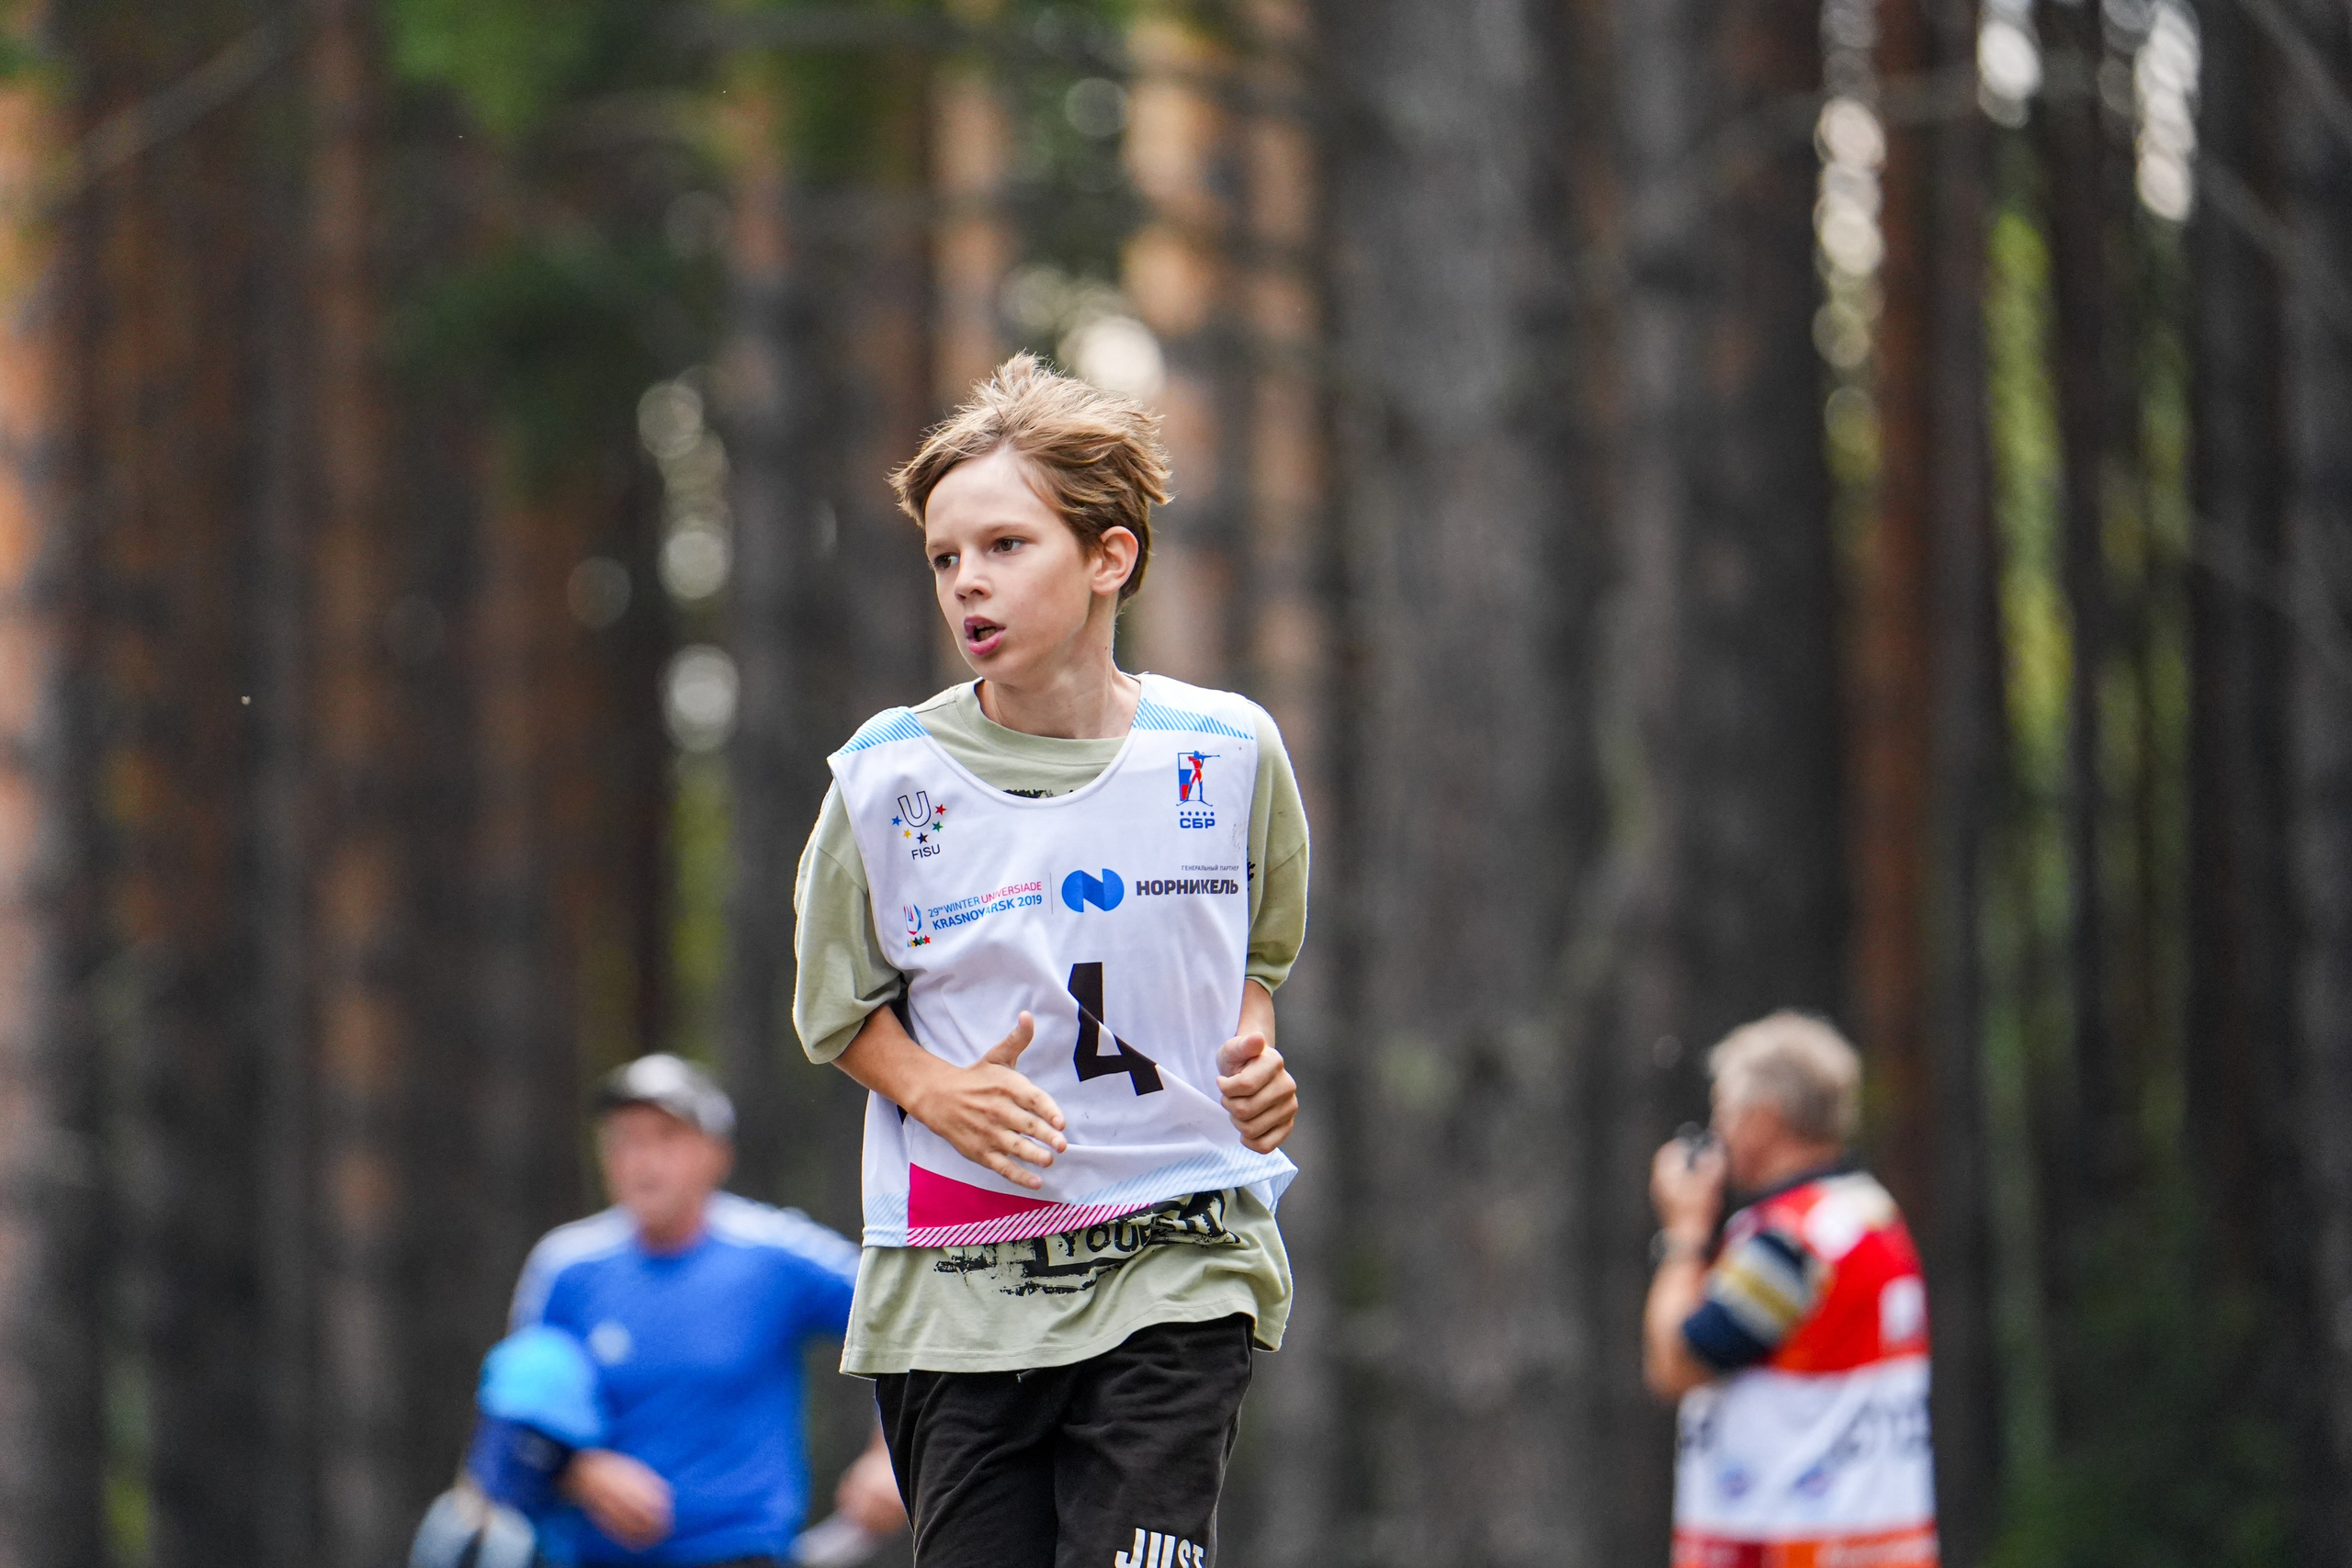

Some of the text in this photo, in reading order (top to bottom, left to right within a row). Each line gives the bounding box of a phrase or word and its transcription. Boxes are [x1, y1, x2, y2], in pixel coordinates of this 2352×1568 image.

[1180, 818, 1216, 829] СБР
[910, 843, 941, 861] FISU
[944, 896, 980, 914] WINTER
[980, 881, 1042, 904] UNIVERSIADE
[1136, 879, 1238, 896] НОРНИКЕЛЬ
[932, 894, 1043, 931] KRASNOYARSK 2019
[1068, 962, 1164, 1097] 4
